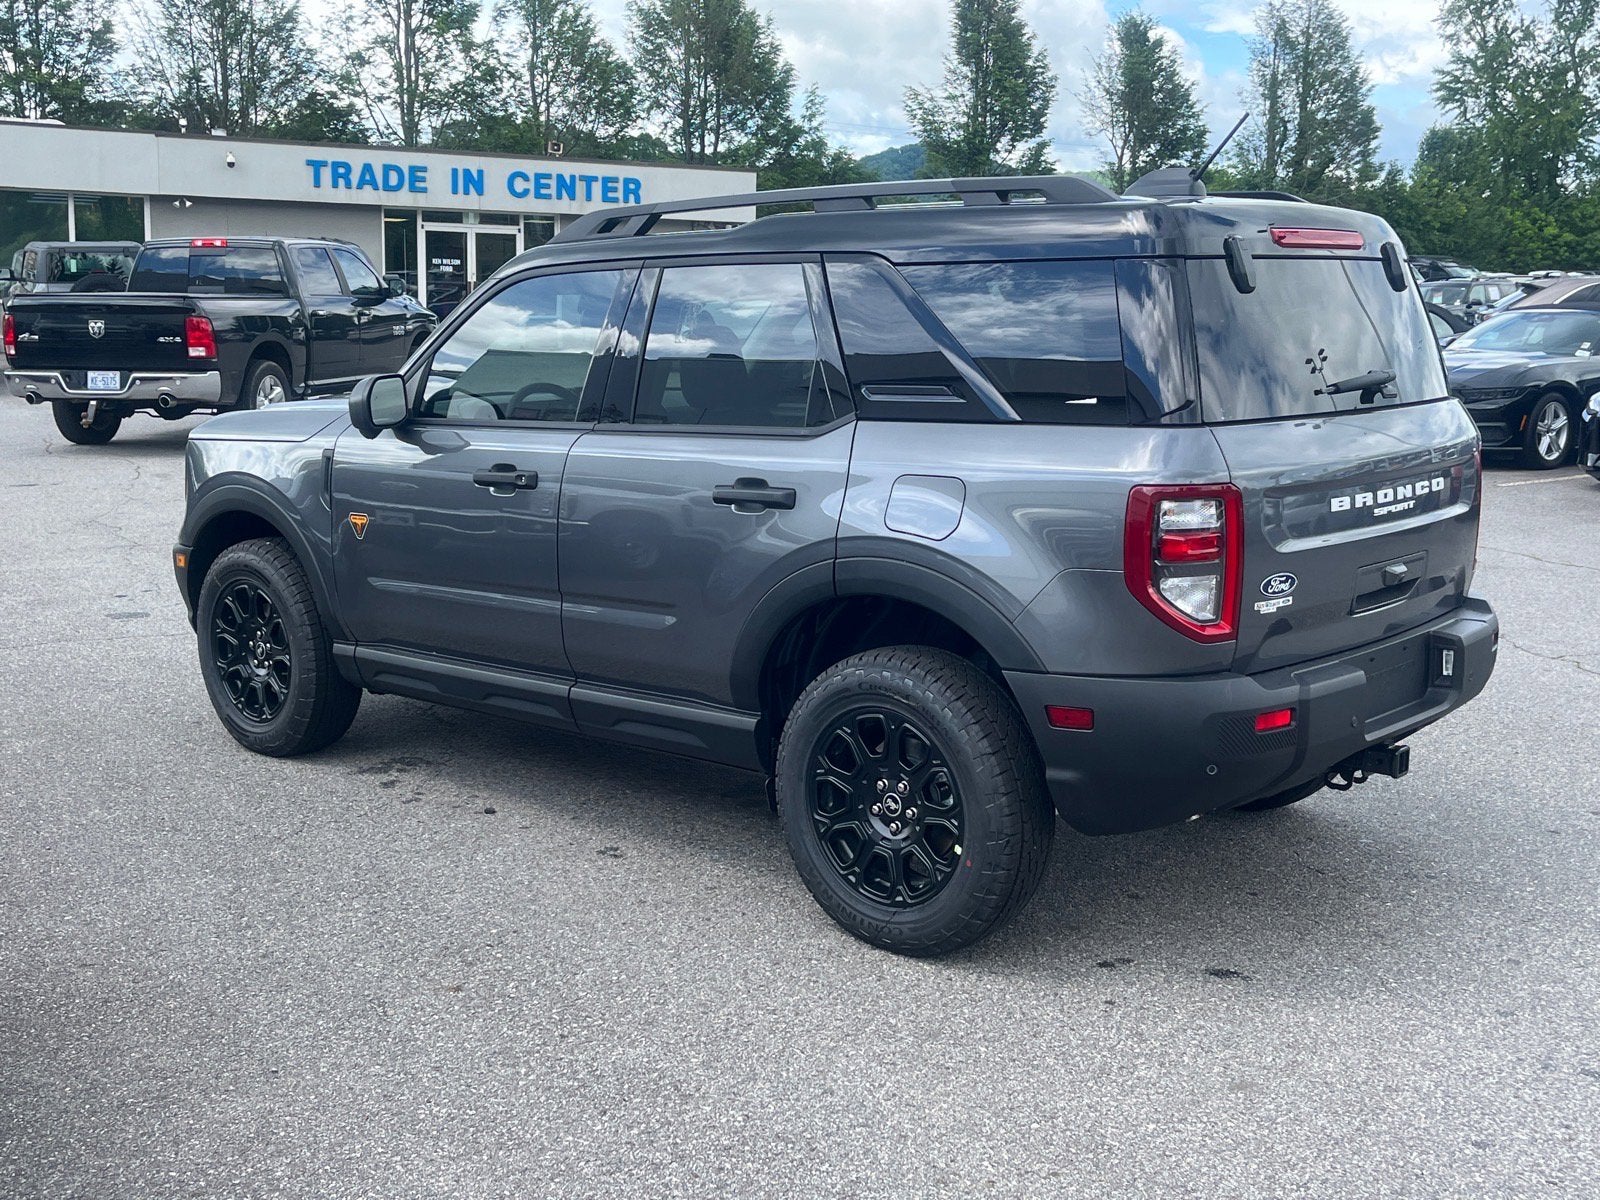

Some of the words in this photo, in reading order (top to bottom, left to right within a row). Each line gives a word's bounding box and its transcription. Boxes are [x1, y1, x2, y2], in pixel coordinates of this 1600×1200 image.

[306, 159, 428, 193] TRADE
[451, 167, 485, 196] IN
[506, 170, 642, 204] CENTER
[442, 258, 461, 266] WILSON
[1330, 476, 1445, 512] BRONCO
[1373, 500, 1416, 517] SPORT
[1267, 576, 1292, 593] Ford
